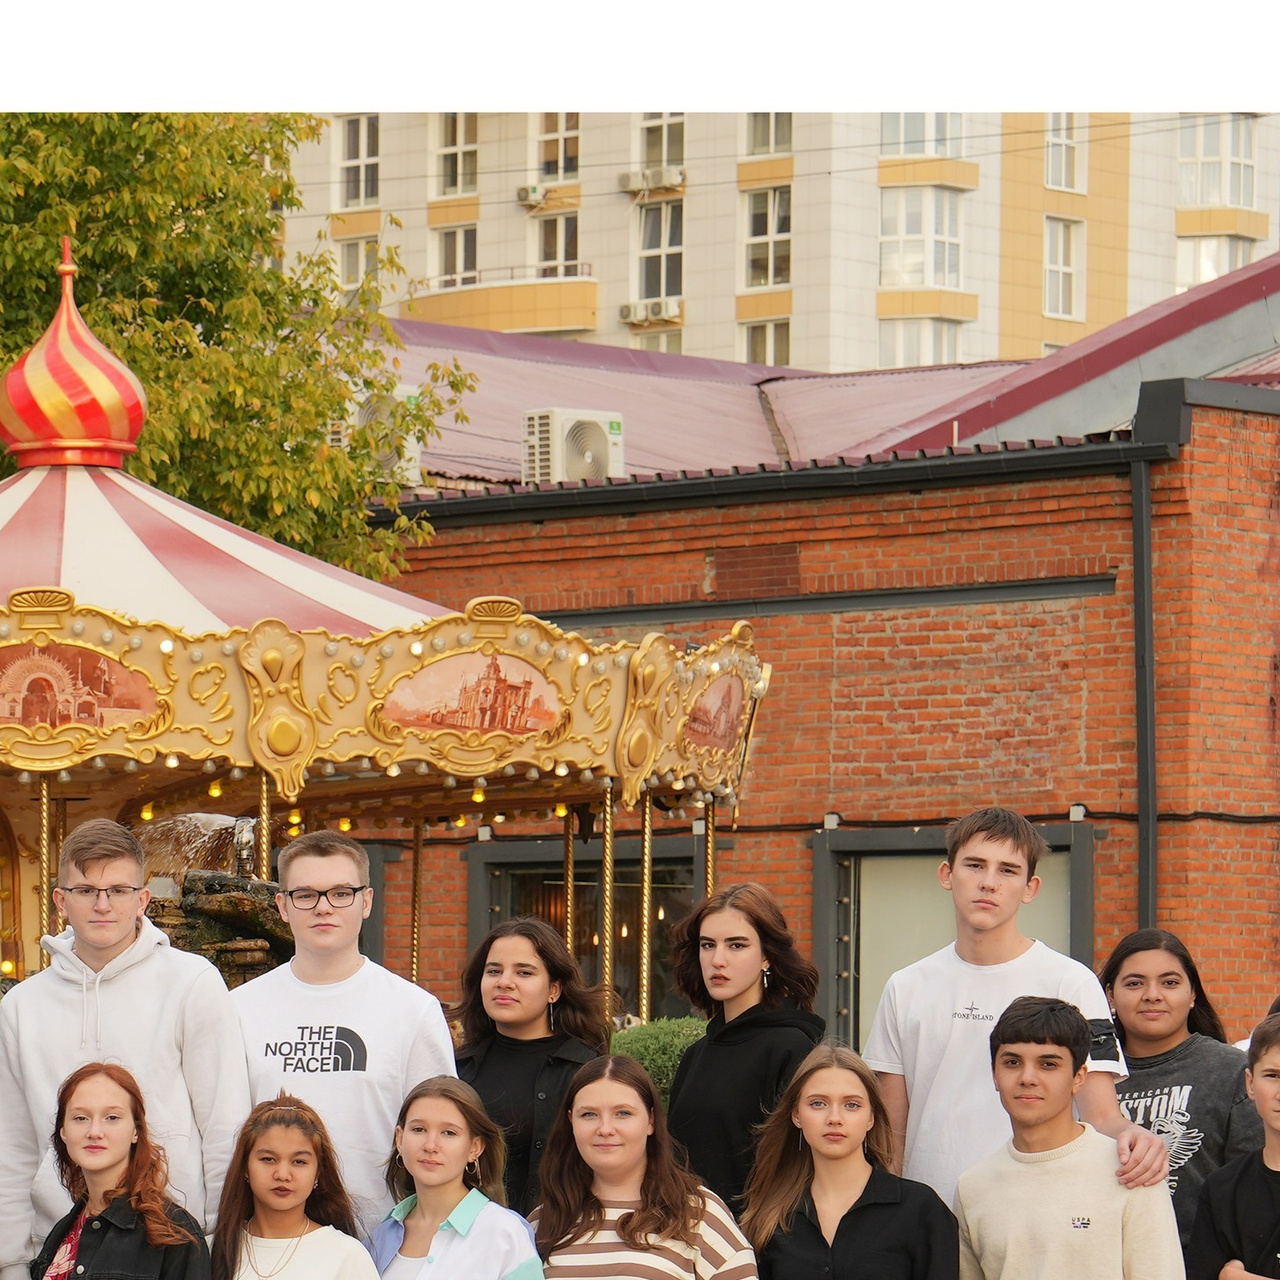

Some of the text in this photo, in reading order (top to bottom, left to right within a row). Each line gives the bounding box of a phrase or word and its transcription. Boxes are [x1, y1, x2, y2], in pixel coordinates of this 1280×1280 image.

[972, 1013, 994, 1021] ISLAND
[297, 1025, 335, 1041] THE
[264, 1041, 333, 1057] NORTH
[283, 1056, 332, 1072] FACE
[1116, 1087, 1170, 1100] MERICAN
[1118, 1085, 1192, 1125] STOM
